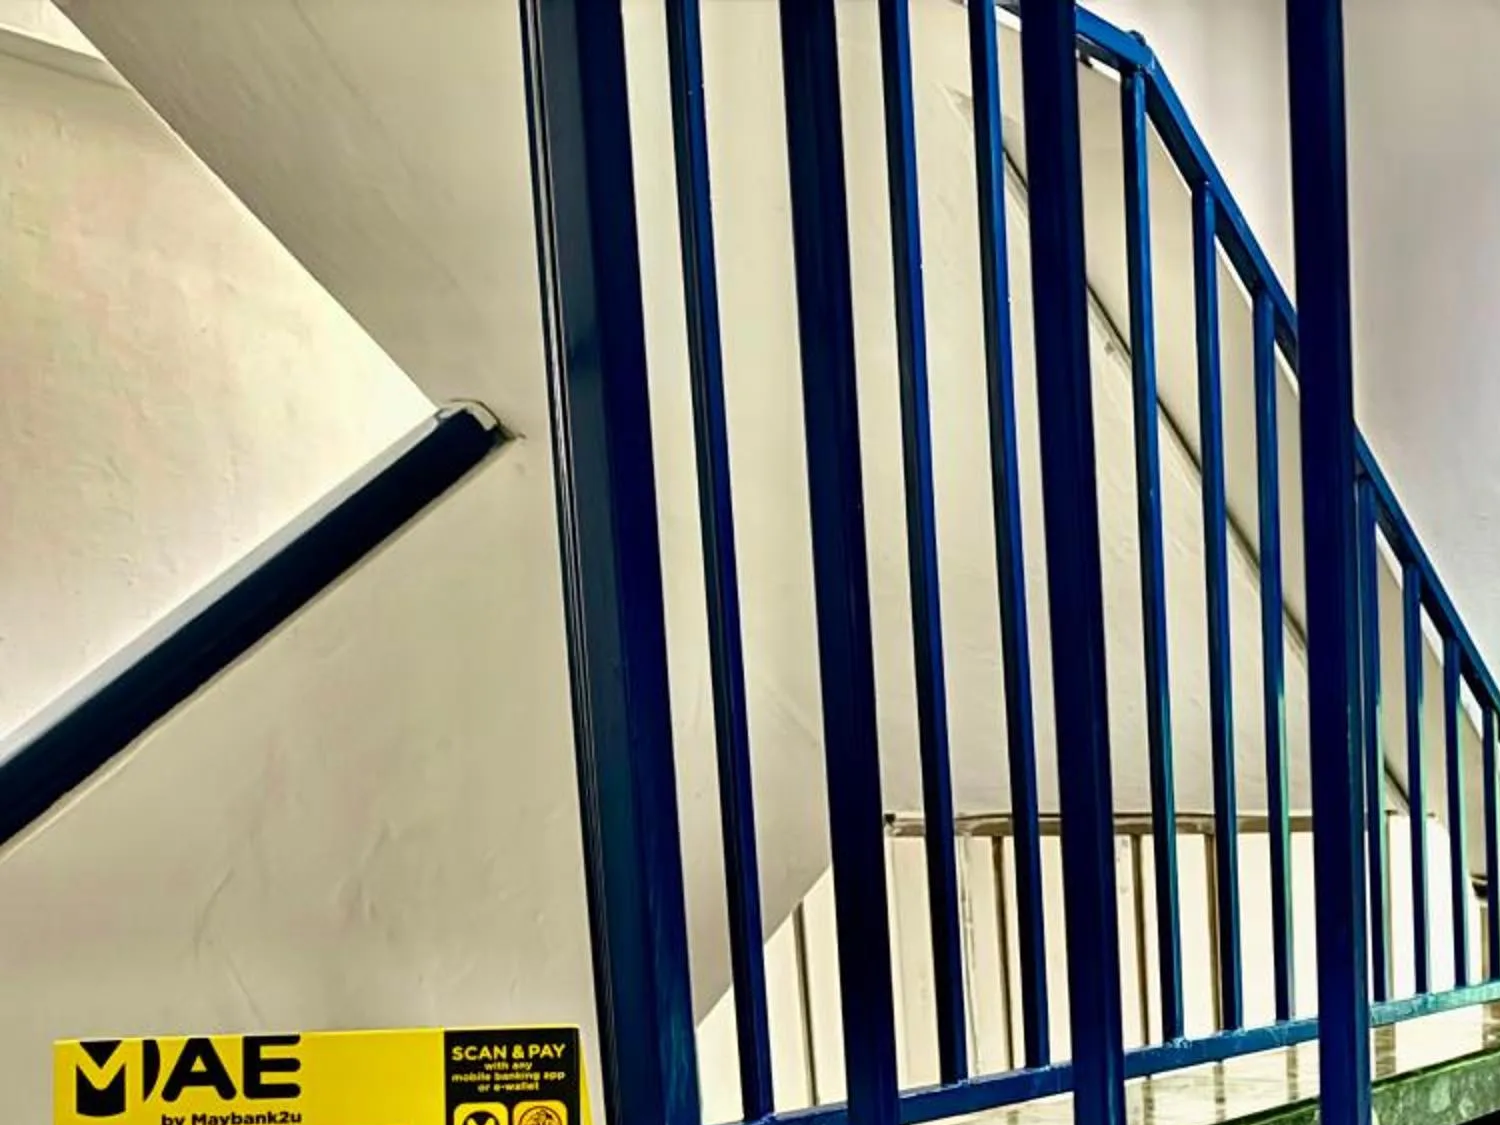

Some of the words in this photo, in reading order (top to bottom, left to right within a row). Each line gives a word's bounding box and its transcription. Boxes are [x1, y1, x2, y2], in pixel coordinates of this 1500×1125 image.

[452, 1045, 507, 1060] SCAN
[512, 1044, 525, 1059] &
[528, 1043, 566, 1059] PAY
[484, 1062, 509, 1071] with
[512, 1061, 532, 1071] any
[451, 1071, 491, 1082] mobile
[494, 1070, 540, 1081] banking
[543, 1070, 565, 1081] app
[477, 1083, 490, 1092] or
[493, 1081, 539, 1092] e-wallet
